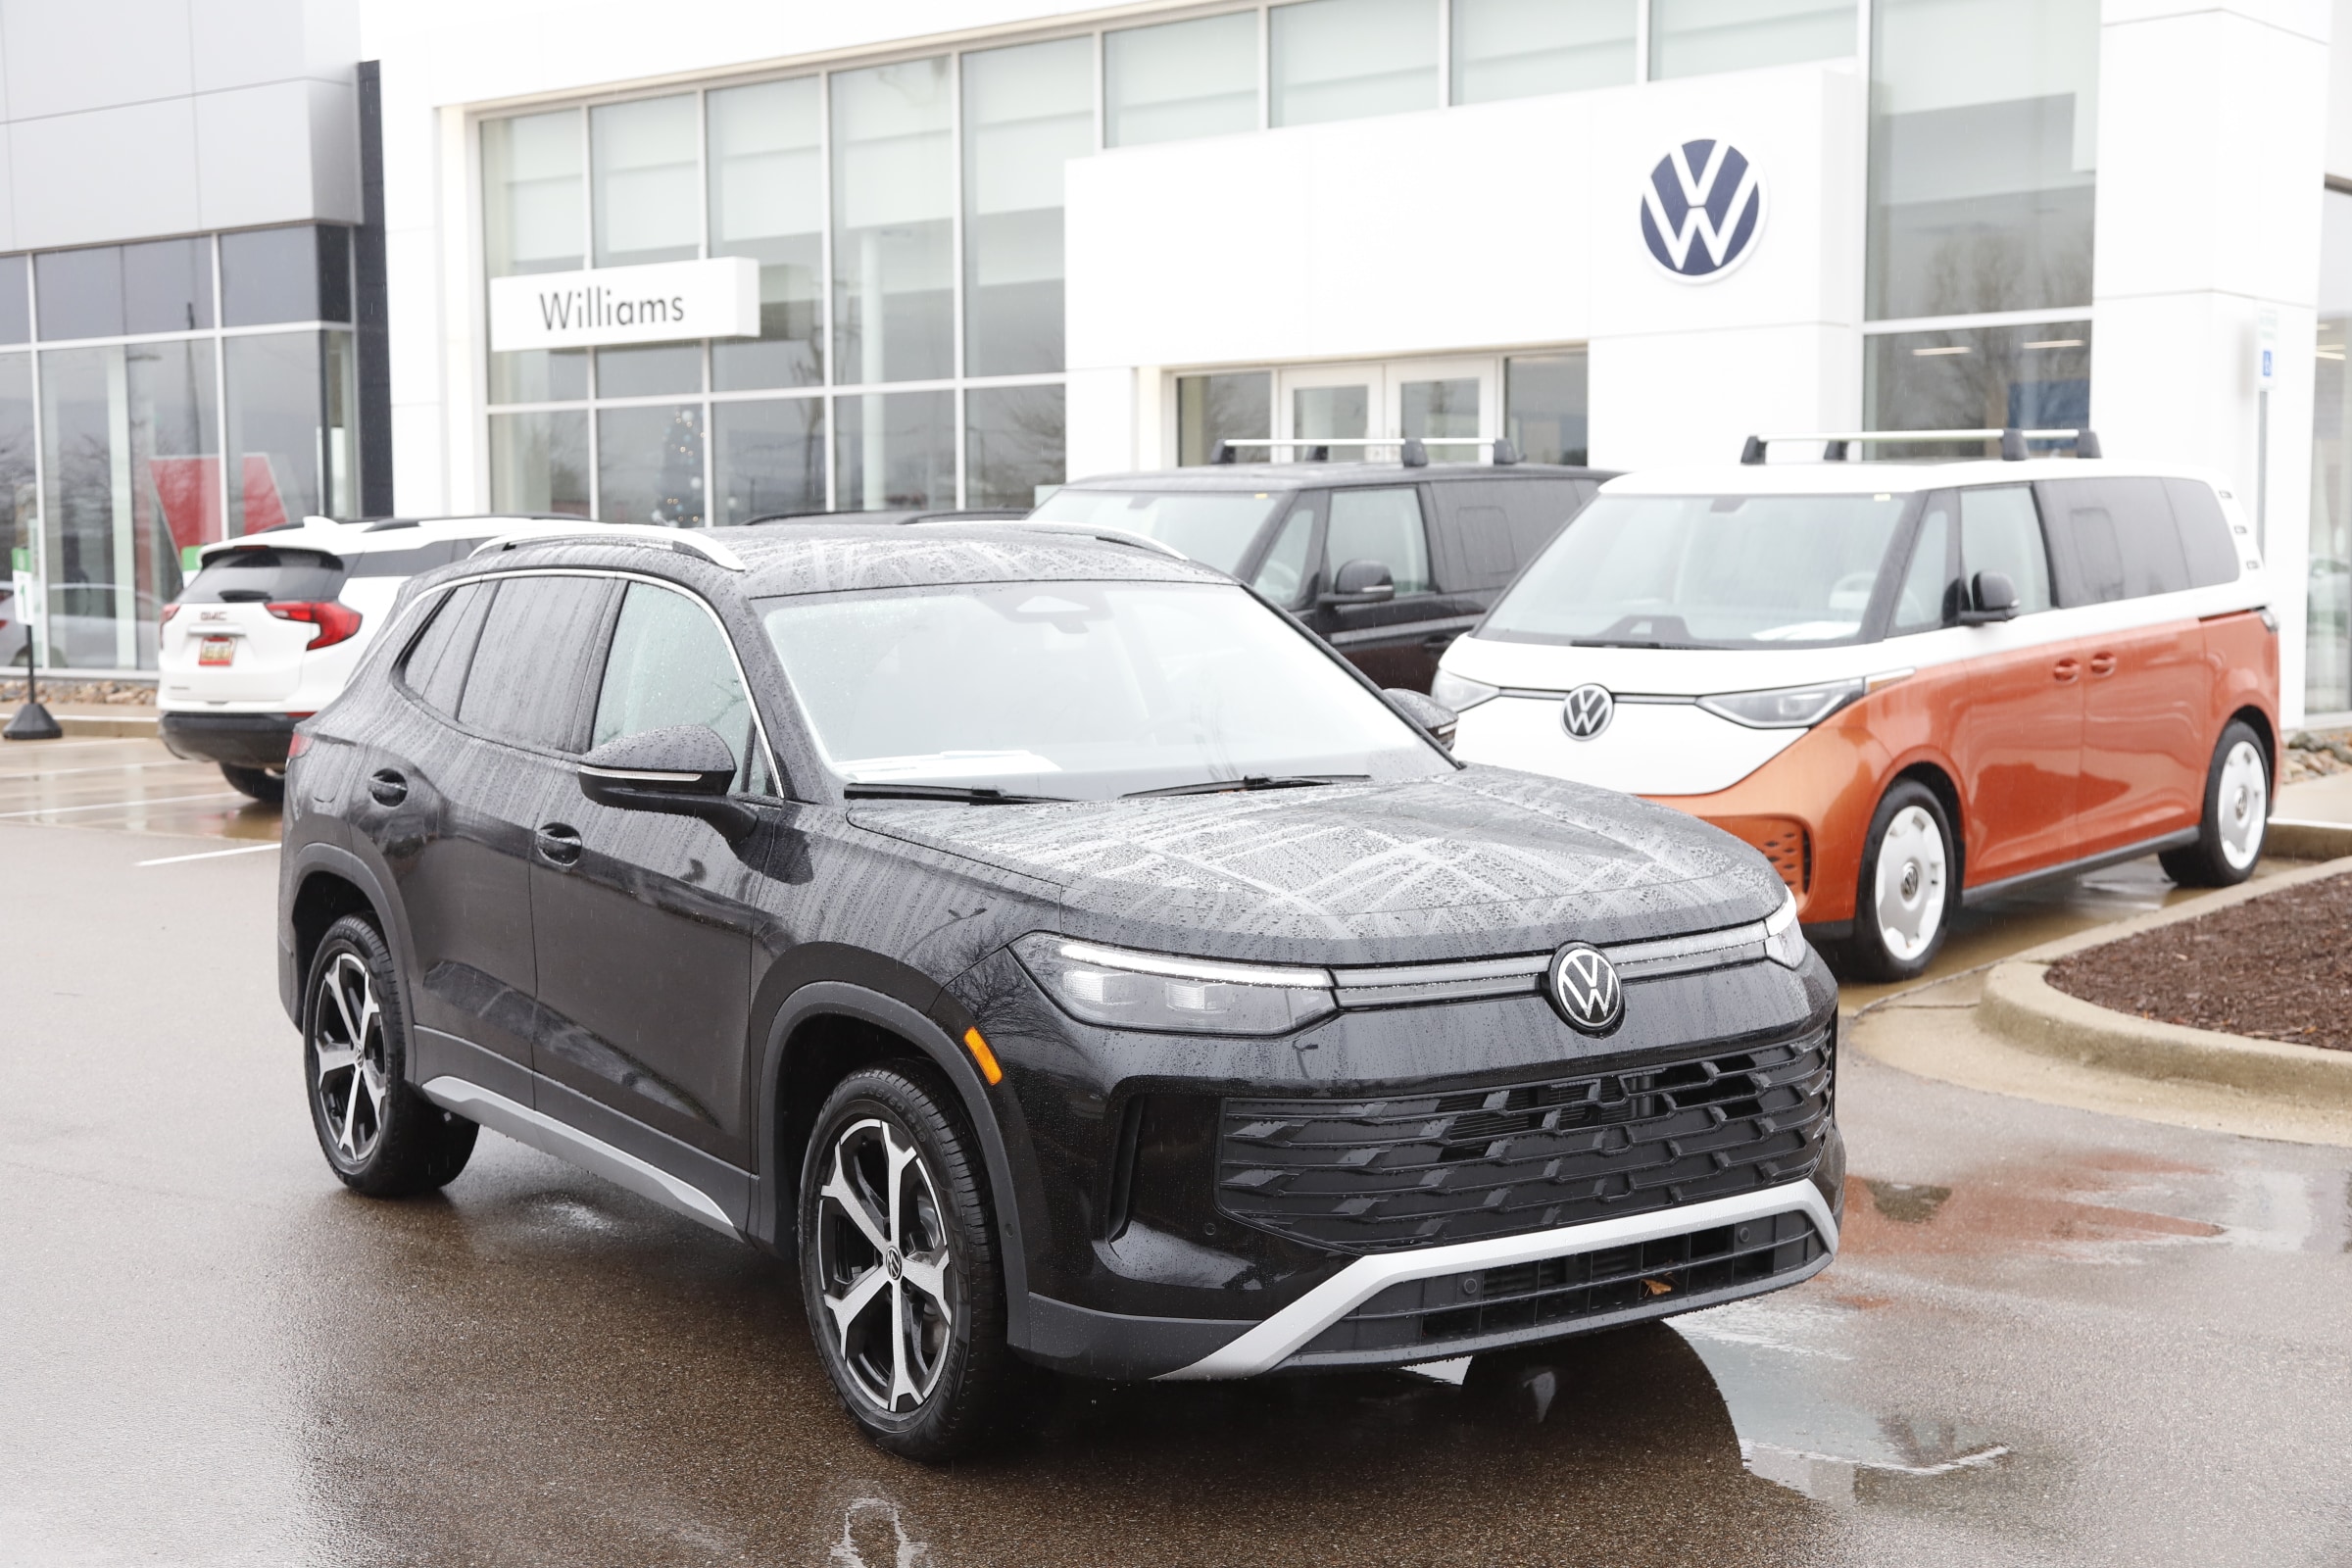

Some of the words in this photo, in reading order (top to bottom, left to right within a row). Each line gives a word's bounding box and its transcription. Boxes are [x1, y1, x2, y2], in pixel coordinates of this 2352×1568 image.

[1641, 138, 1760, 276] VW
[539, 285, 684, 330] Williams
[1561, 684, 1612, 741] VW
[1557, 948, 1620, 1027] VW
